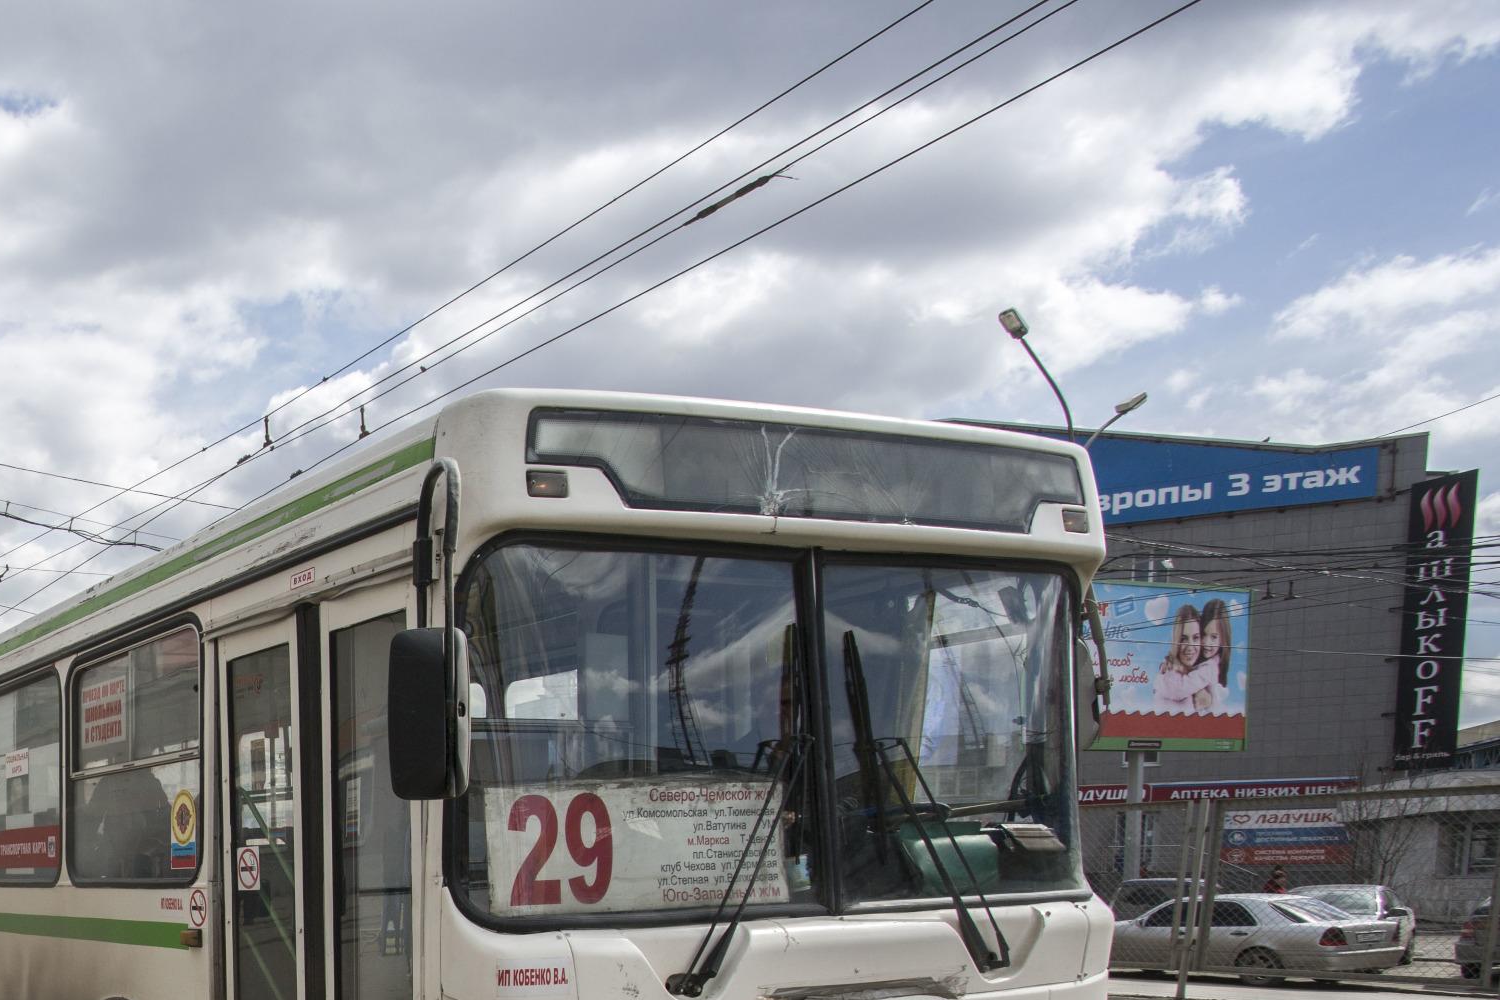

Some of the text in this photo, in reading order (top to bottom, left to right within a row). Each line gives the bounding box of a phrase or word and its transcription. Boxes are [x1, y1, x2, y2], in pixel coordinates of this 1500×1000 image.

[1227, 473, 1250, 496] 3
[1261, 465, 1362, 493] этаж
[293, 571, 312, 585] ВХОД
[1171, 787, 1229, 800] АПТЕКА
[1234, 785, 1299, 799] НИЗКИХ
[1304, 784, 1338, 796] ЦЕН
[714, 806, 775, 820] ул.Тюменсая
[693, 820, 747, 833] ул.Ватутина
[687, 835, 730, 847] м.Маркса
[508, 792, 612, 906] 29
[660, 862, 681, 874] клуб
[684, 861, 716, 871] Чехова
[658, 874, 709, 886] ул.Степная
[497, 967, 569, 986] ИП КОБЕНКО В.А.
